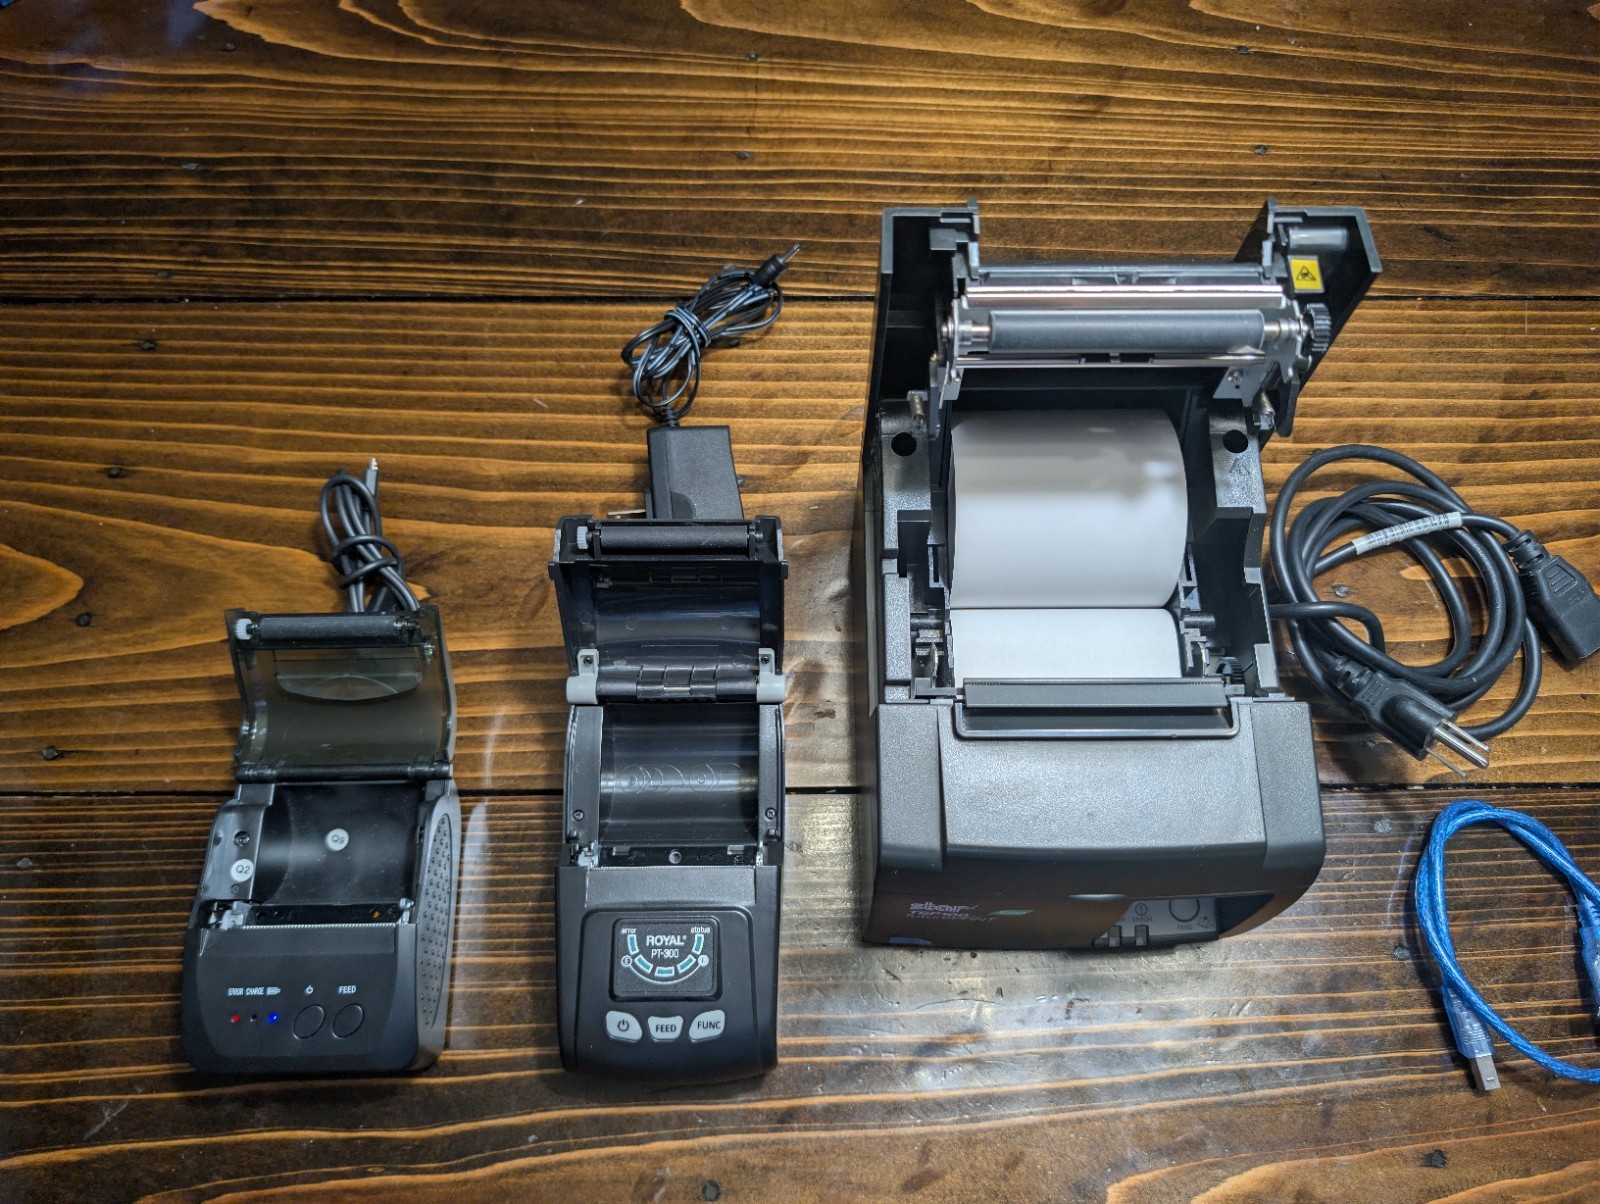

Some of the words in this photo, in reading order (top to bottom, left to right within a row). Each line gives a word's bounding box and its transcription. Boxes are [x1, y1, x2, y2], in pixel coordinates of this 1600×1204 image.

[331, 834, 345, 844] Q9
[236, 864, 250, 874] Q2
[690, 926, 711, 934] status
[646, 935, 685, 946] ROYAL
[651, 948, 679, 959] PT-300
[338, 985, 356, 994] FEED
[655, 1023, 677, 1033] FEED
[697, 1020, 721, 1030] FUNC
